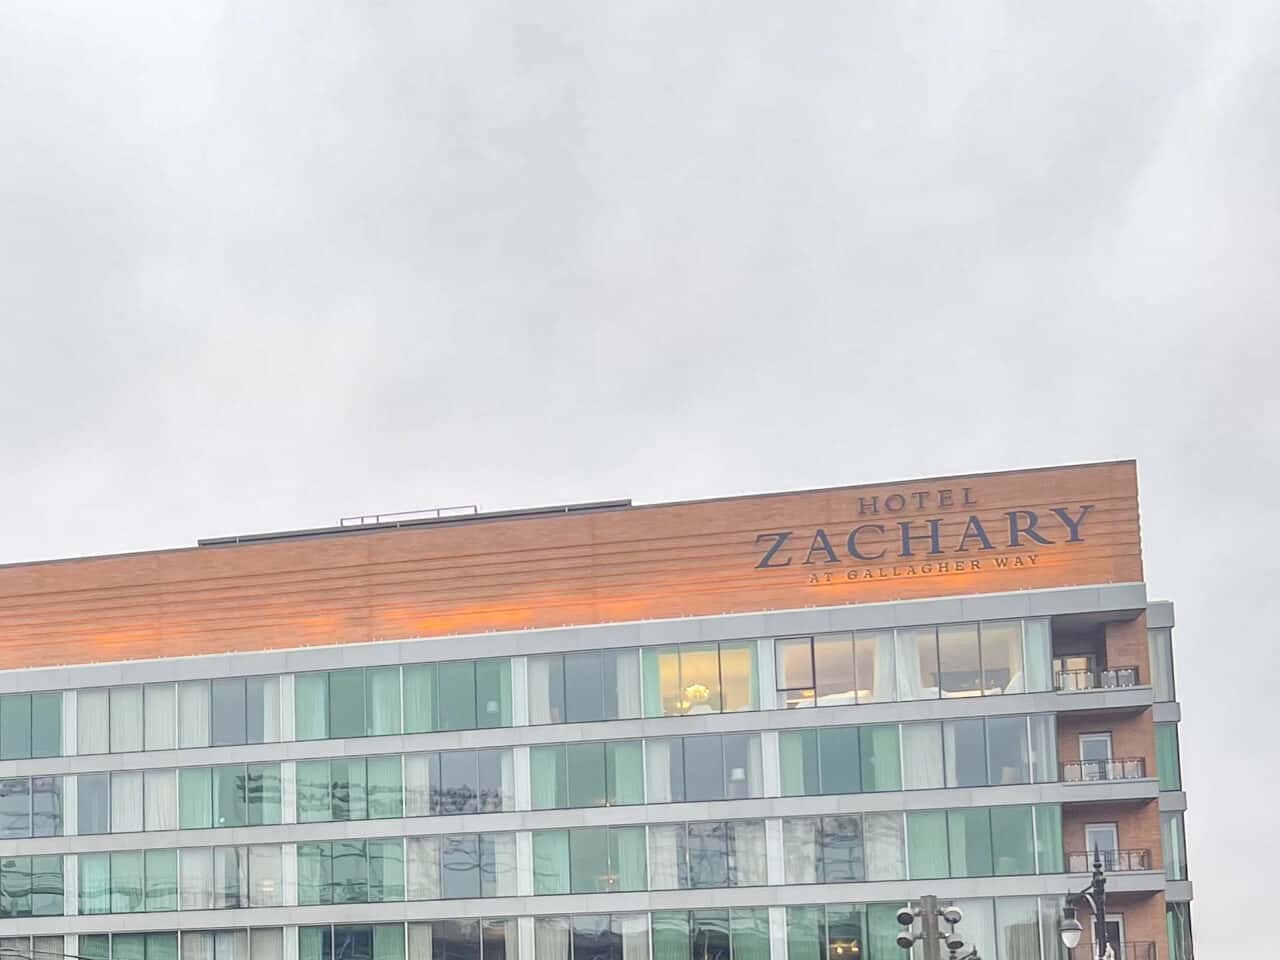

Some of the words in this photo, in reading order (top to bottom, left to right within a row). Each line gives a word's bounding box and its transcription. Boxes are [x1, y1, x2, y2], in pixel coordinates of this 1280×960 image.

[858, 487, 977, 515] HOTEL
[754, 504, 1095, 569] ZACHARY
[809, 570, 833, 584] AT
[847, 559, 983, 581] GALLAGHER
[994, 554, 1039, 567] WAY
